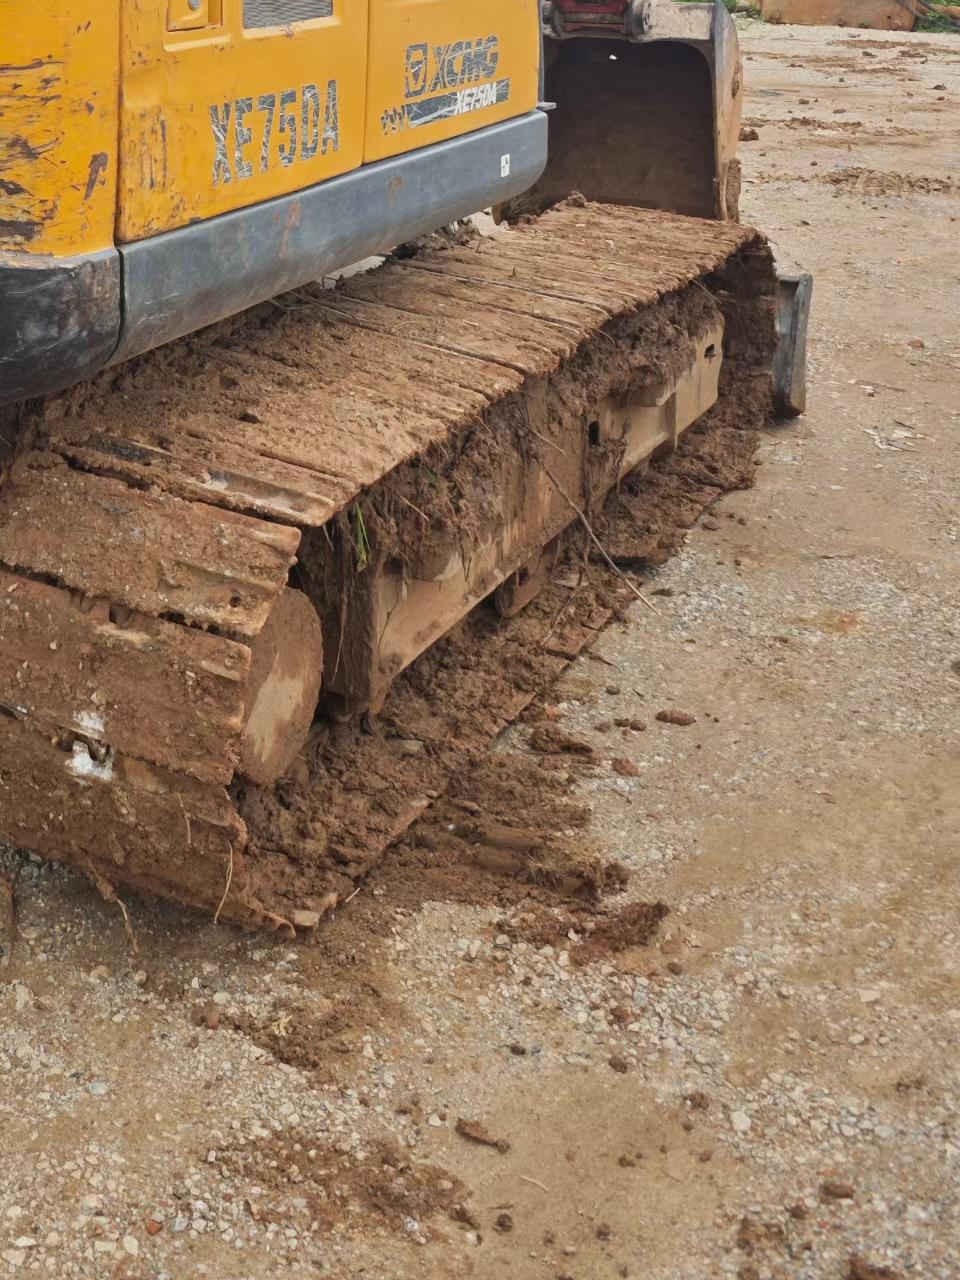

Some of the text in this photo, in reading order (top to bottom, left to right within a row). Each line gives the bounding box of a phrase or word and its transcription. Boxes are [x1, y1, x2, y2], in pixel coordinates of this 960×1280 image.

[428, 34, 500, 93] XCMG
[454, 81, 497, 115] XE75DA
[209, 79, 339, 187] XE75DA
